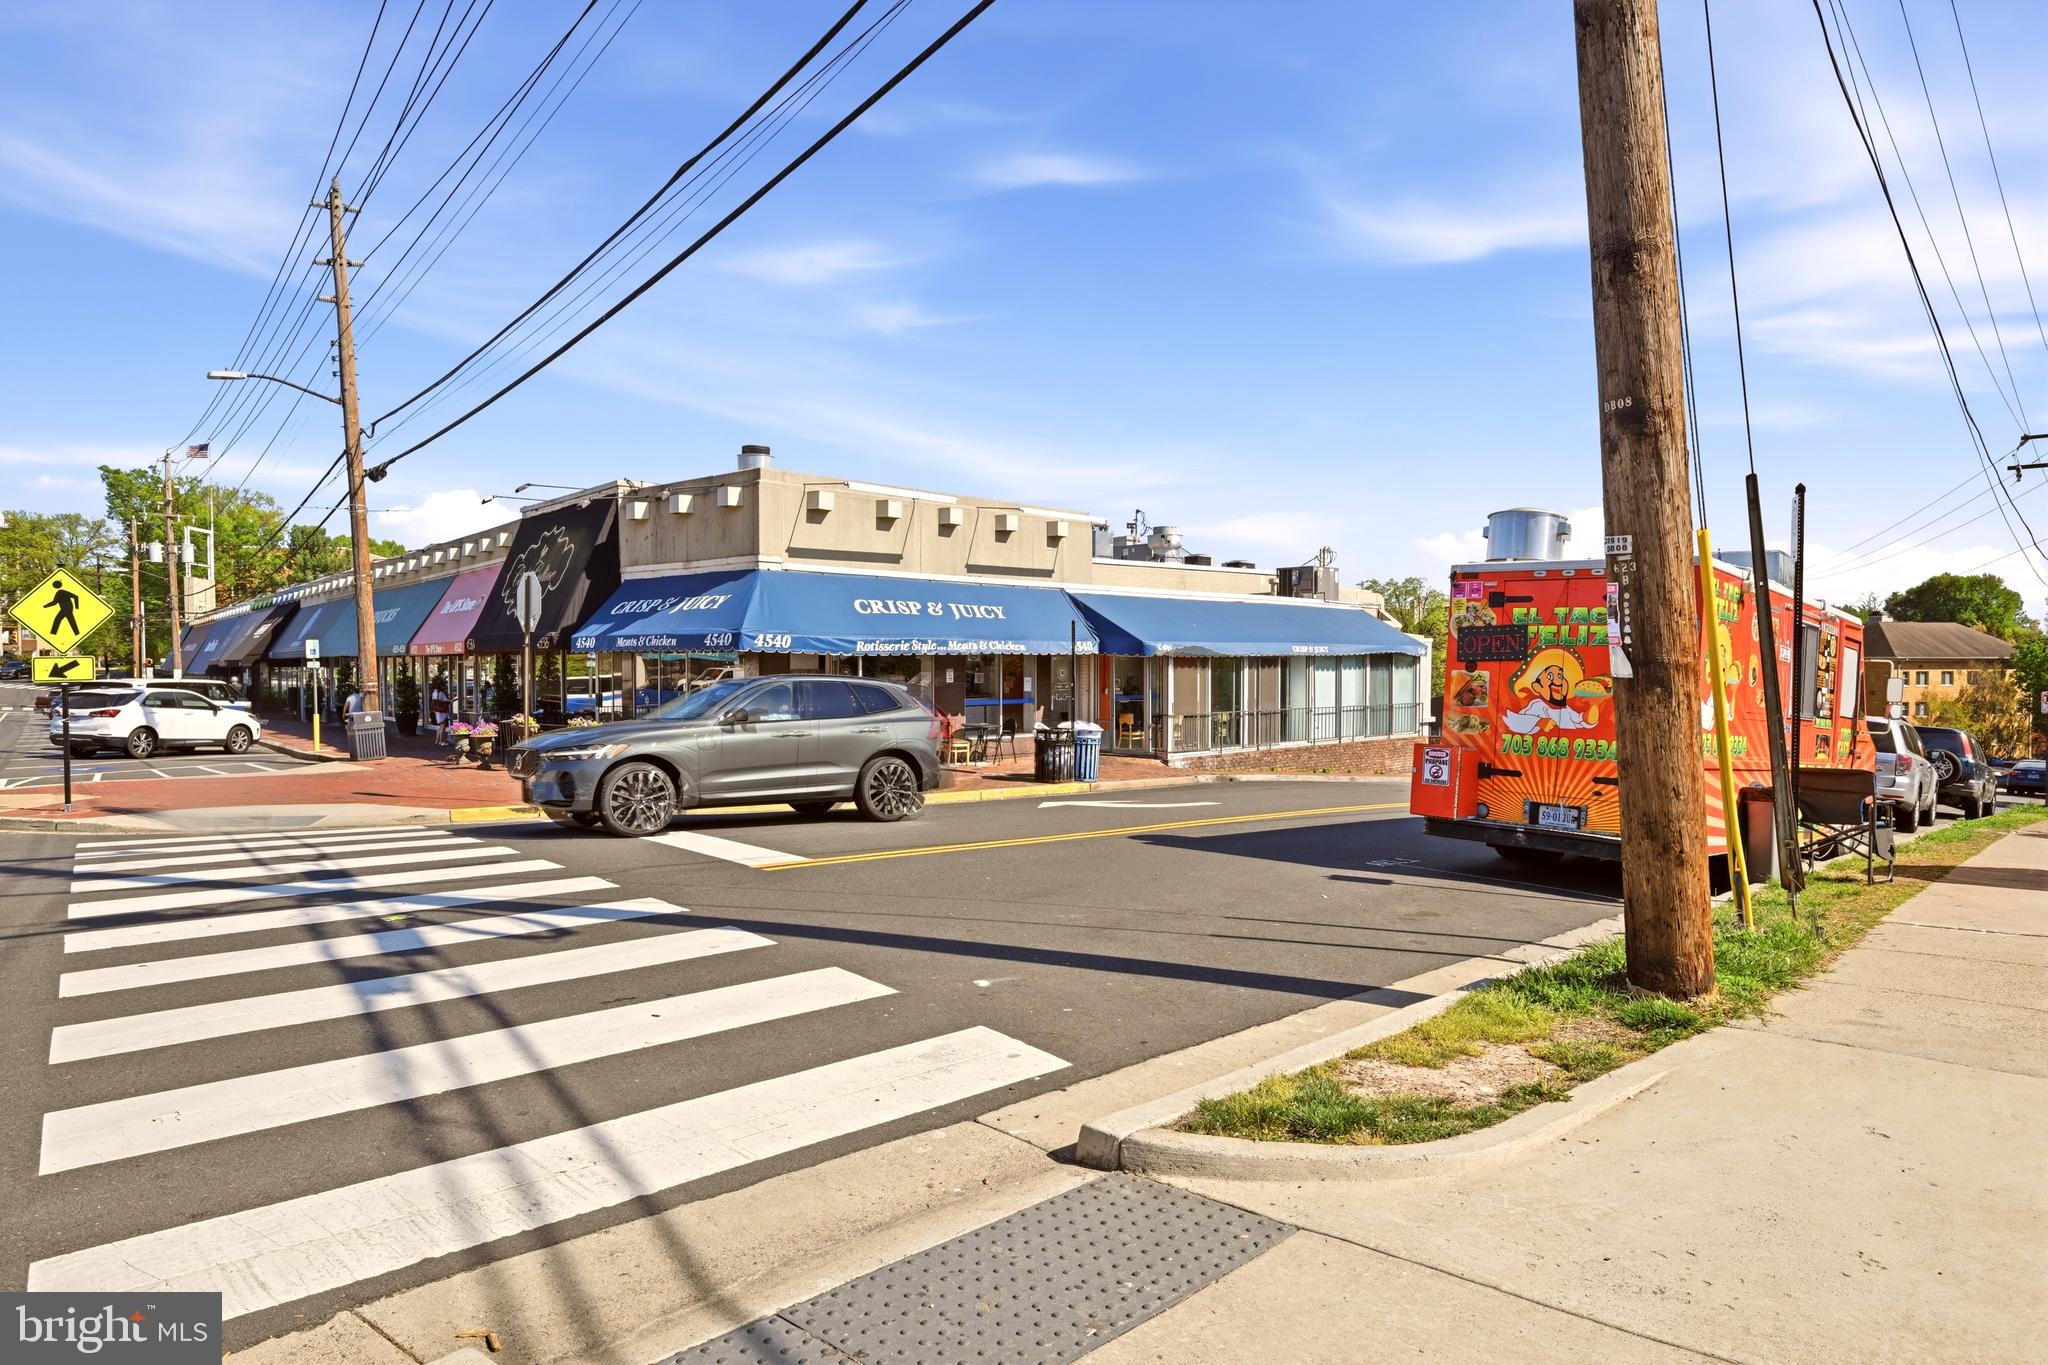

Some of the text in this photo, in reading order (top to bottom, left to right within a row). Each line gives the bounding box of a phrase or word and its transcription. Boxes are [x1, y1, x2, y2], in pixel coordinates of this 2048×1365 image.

[1604, 396, 1632, 413] DB08
[1614, 562, 1637, 573] 623
[611, 595, 732, 615] CRISP & JUICY
[854, 599, 1007, 620] CRISP & JUICY
[1512, 607, 1608, 624] EL TAC
[576, 637, 596, 648] 4540
[616, 637, 637, 647] Meats
[645, 635, 677, 647] Chicken
[703, 633, 732, 647] 4540
[754, 634, 792, 648] 4540
[1464, 634, 1521, 653] OPEN
[1527, 626, 1610, 646] FELIZ
[856, 641, 910, 652] Rotisserie
[979, 641, 988, 650] &
[989, 642, 1026, 652] Chicken
[1074, 641, 1093, 651] 540
[1501, 733, 1617, 761] 703 868 9334
